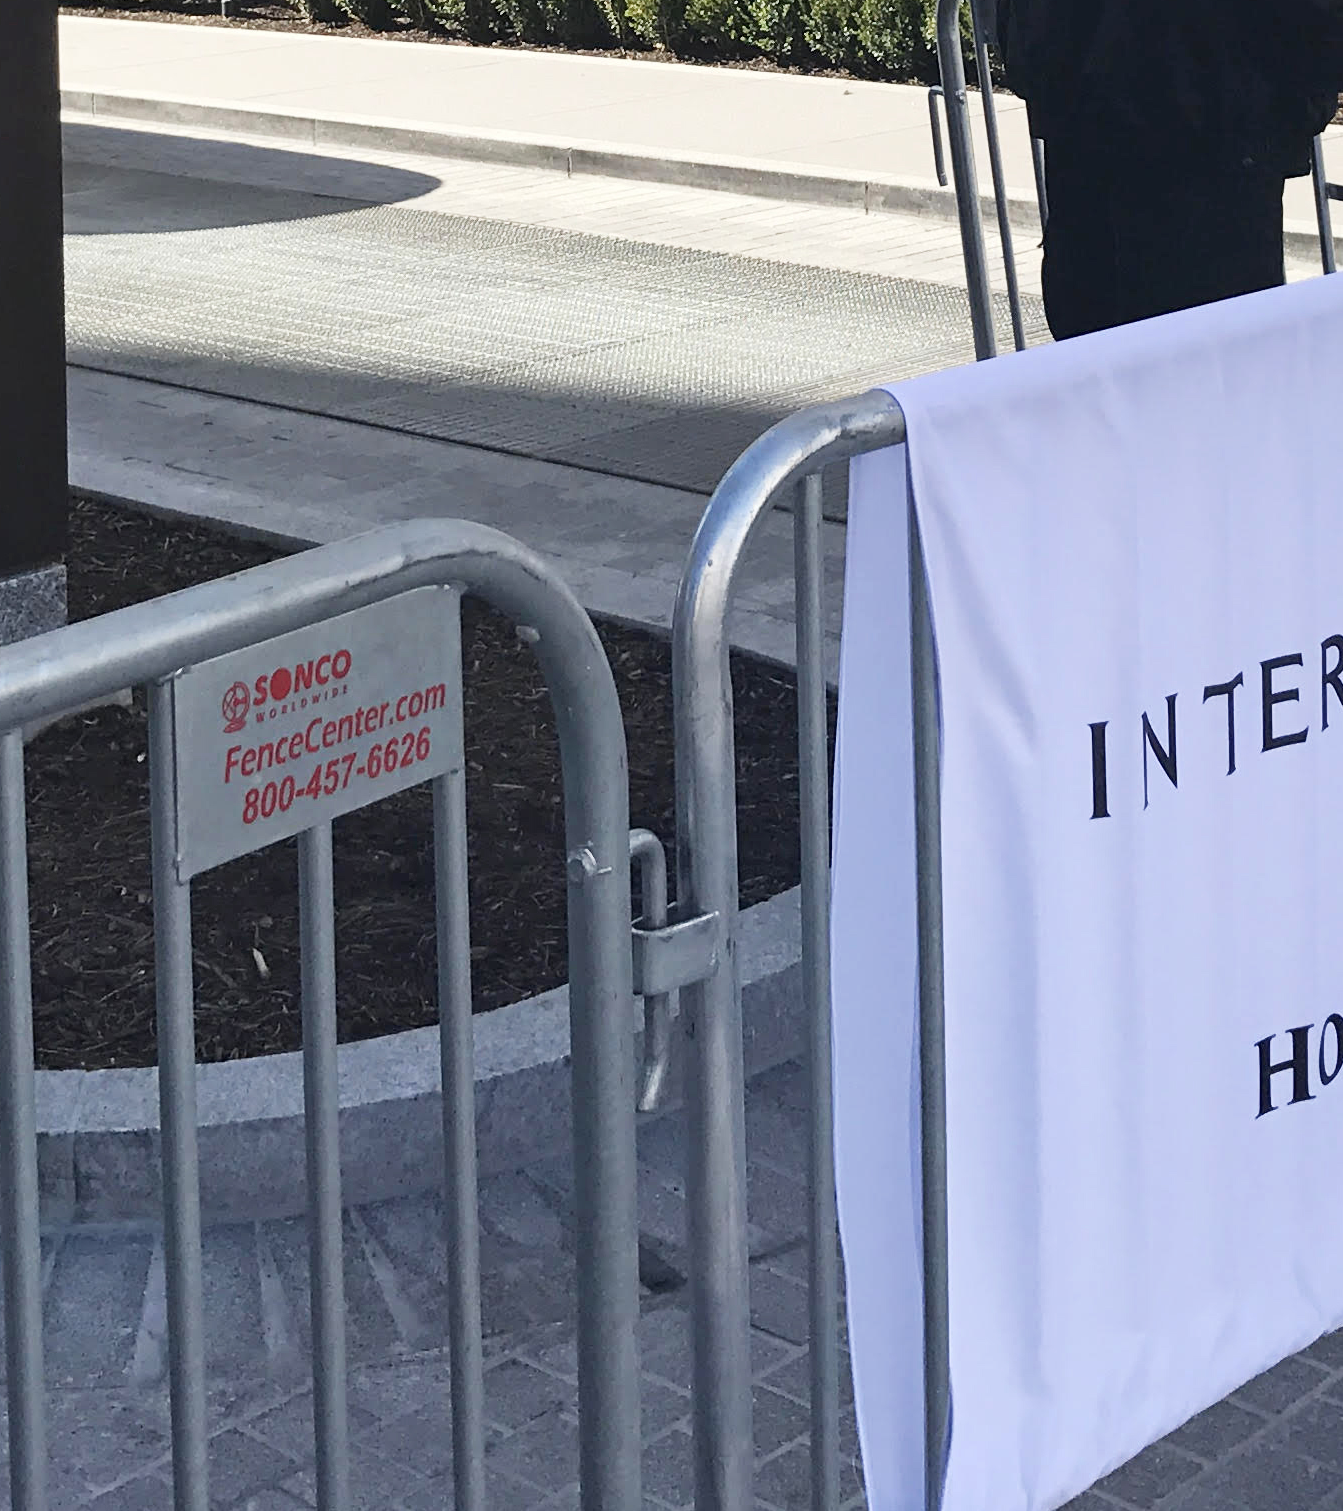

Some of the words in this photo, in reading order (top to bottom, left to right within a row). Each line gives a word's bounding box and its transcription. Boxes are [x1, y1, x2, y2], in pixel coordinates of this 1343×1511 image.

[253, 649, 352, 706] SONCO
[256, 684, 349, 723] WORLDWIDE
[224, 683, 446, 784] FenceCenter.com
[242, 726, 431, 825] 800-457-6626
